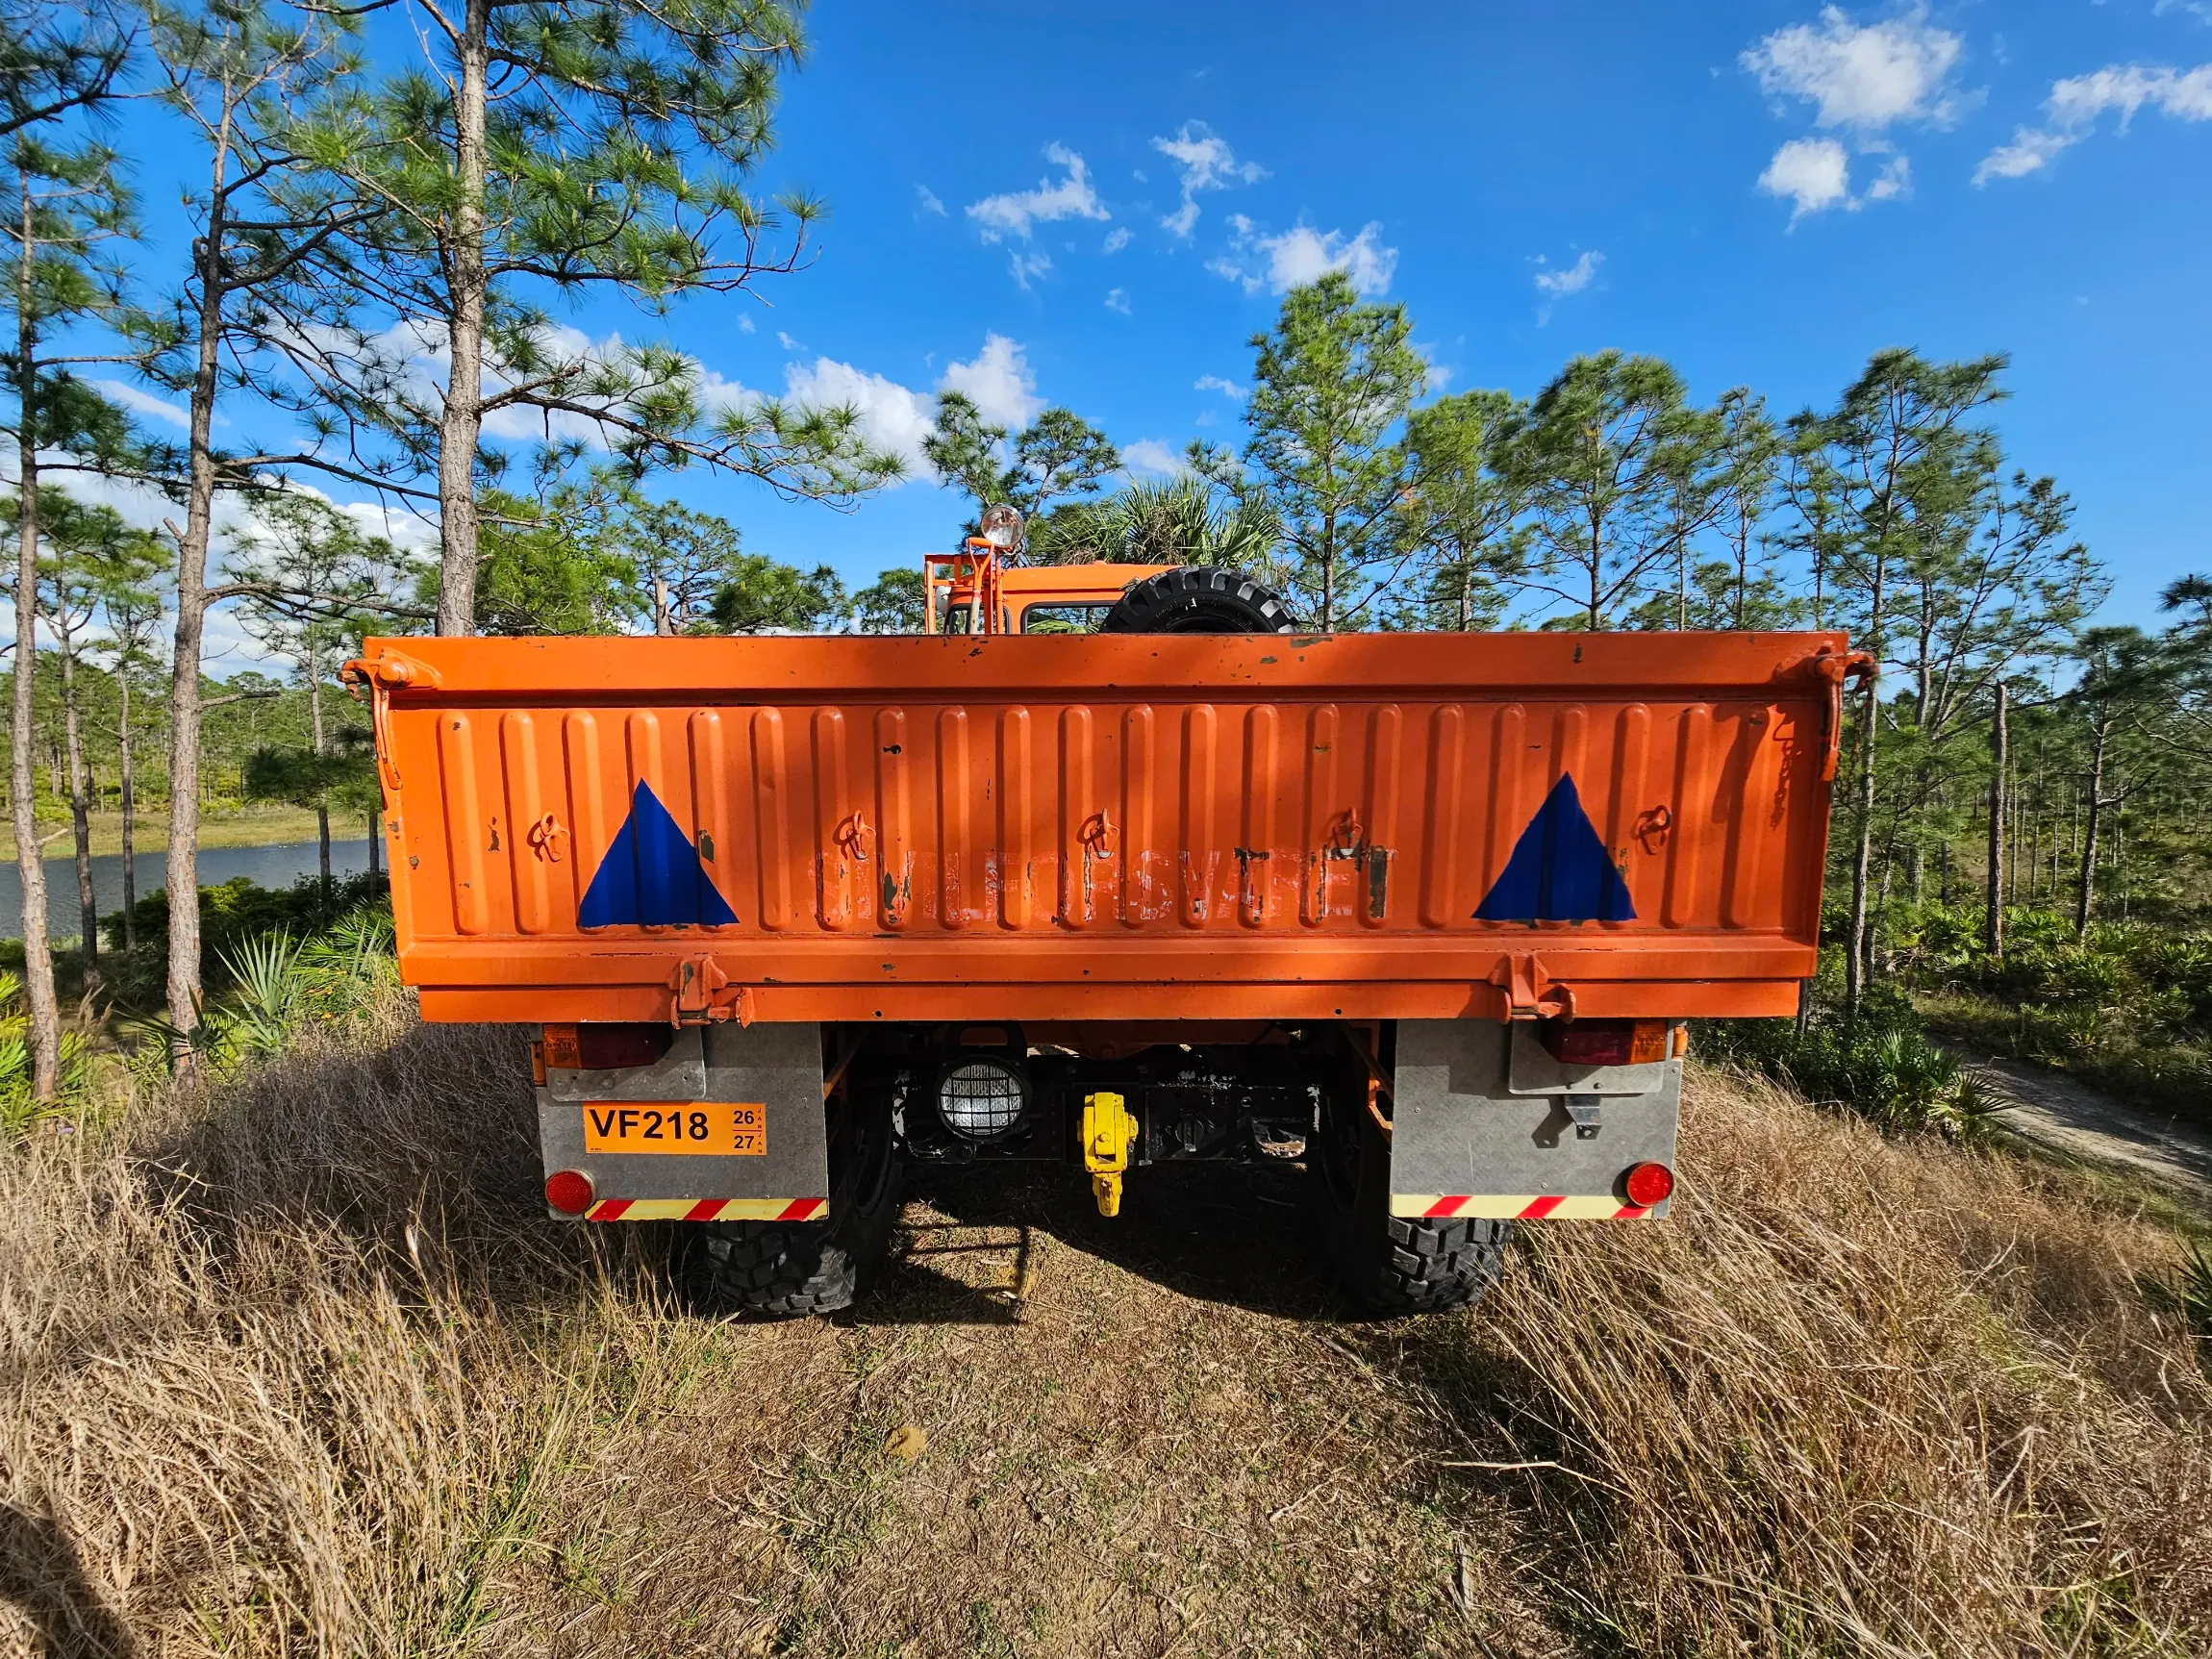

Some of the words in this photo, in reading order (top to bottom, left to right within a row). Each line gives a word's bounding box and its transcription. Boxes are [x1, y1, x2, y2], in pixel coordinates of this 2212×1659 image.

[589, 1109, 709, 1141] VF218
[733, 1110, 755, 1125] 26
[734, 1135, 755, 1149] 27
